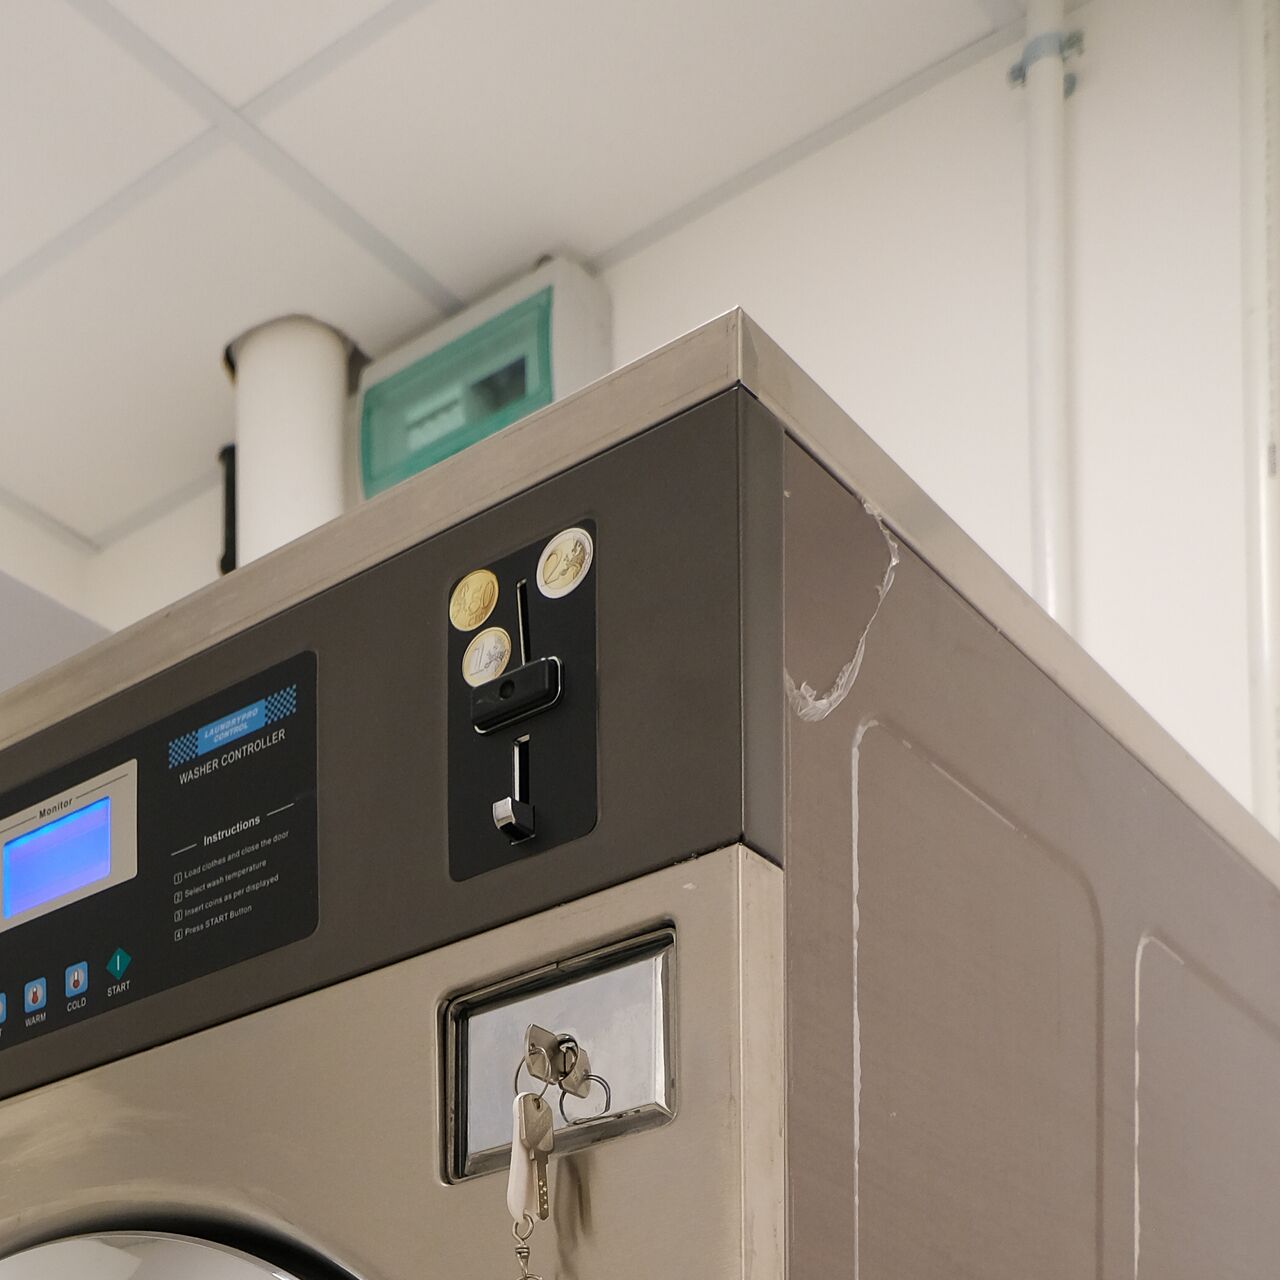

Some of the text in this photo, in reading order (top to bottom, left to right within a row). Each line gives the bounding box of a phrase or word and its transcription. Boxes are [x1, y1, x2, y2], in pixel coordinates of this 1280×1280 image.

[179, 728, 286, 784] WASHER CONTROLLER
[39, 798, 72, 818] Monitor
[203, 816, 261, 846] Instructions
[184, 866, 200, 879] Load
[202, 857, 226, 873] clothes
[227, 850, 240, 861] and
[241, 843, 259, 856] close
[260, 838, 271, 847] the
[273, 830, 289, 842] door
[185, 883, 206, 898] Select
[206, 876, 224, 889] wash
[225, 860, 267, 880] temperature
[185, 903, 204, 917] Insert
[205, 897, 223, 910] coins
[224, 893, 232, 902] as
[233, 888, 244, 900] per
[245, 873, 279, 893] displayed
[185, 923, 204, 936] Press
[205, 913, 228, 929] START
[229, 905, 253, 919] Button
[107, 980, 131, 997] START
[25, 1012, 47, 1027] WARM
[66, 997, 87, 1012] COLD
